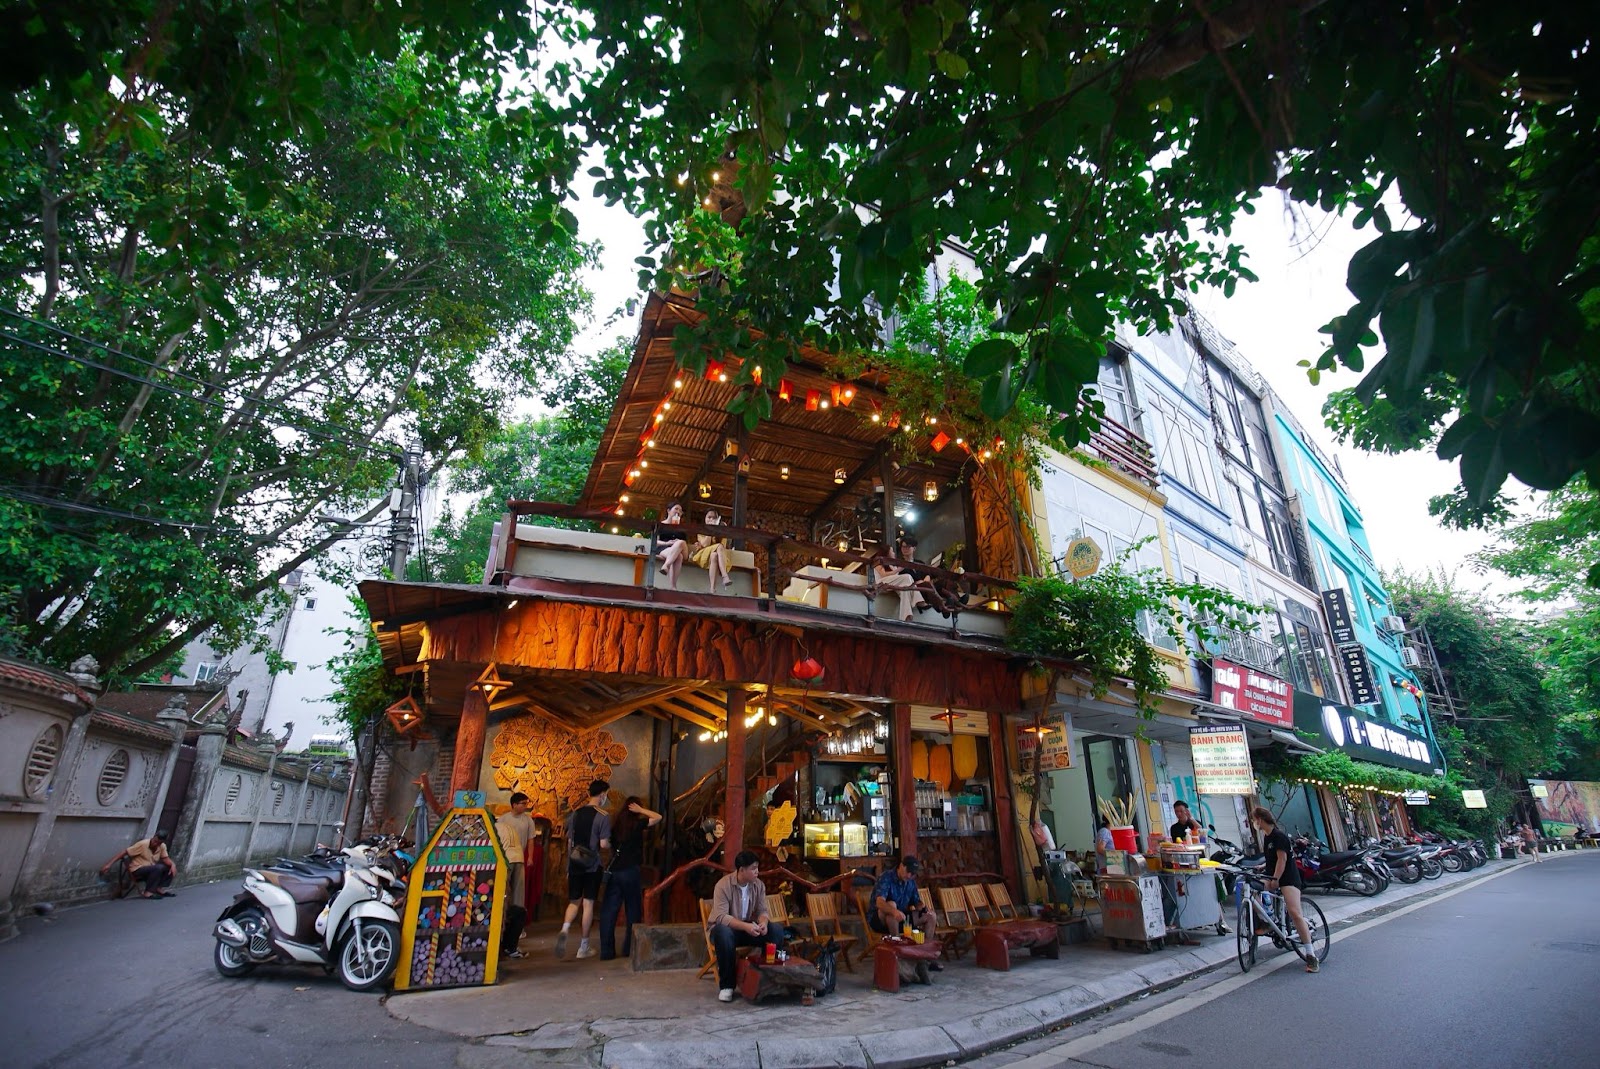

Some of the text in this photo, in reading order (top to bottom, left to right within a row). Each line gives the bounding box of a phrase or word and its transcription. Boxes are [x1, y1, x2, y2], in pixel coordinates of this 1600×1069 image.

[1348, 653, 1370, 702] ROOFTOP
[1191, 734, 1244, 745] BÁNH TRÁNG
